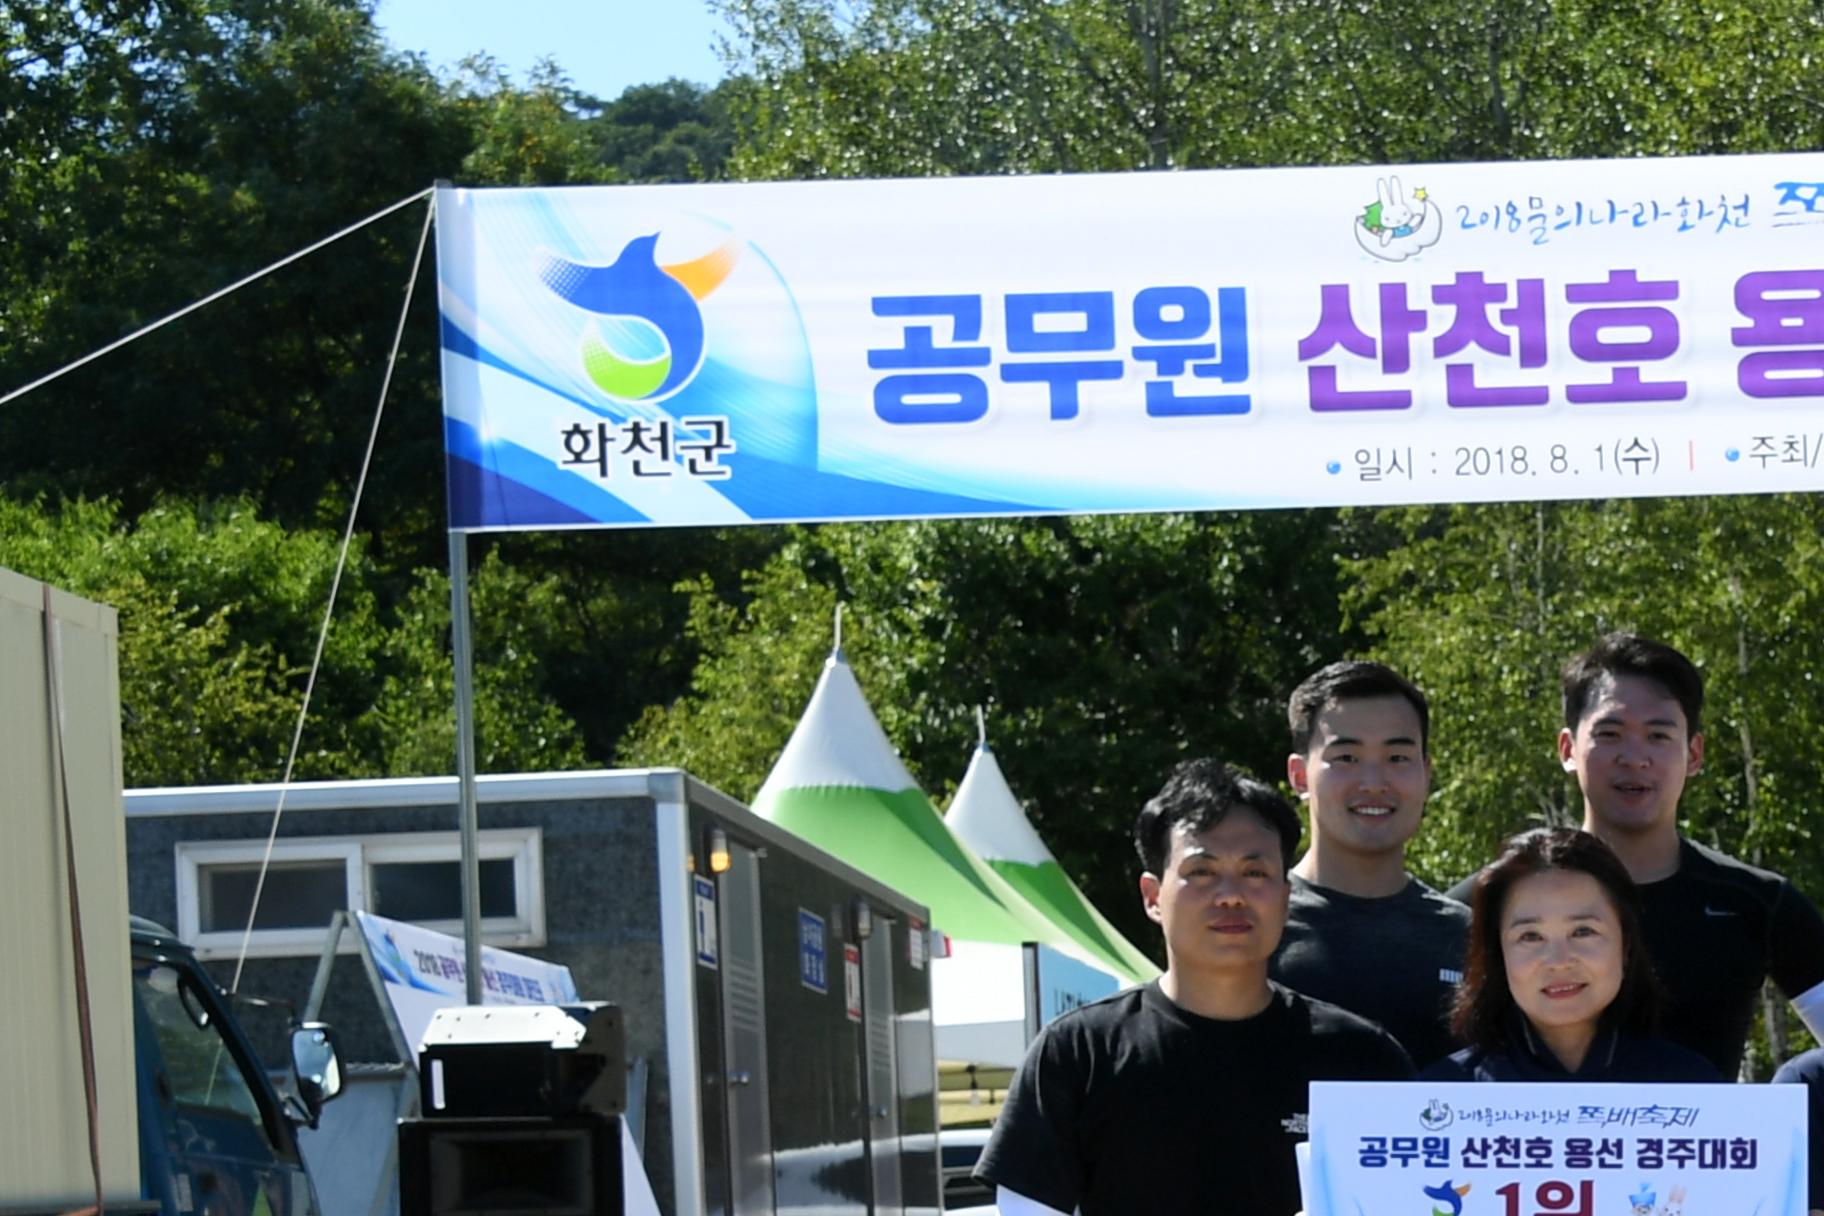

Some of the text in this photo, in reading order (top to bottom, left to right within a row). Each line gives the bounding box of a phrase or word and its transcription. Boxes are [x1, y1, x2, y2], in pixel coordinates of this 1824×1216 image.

[867, 286, 1251, 425] 공무원
[1298, 269, 1687, 412] 산천호
[561, 420, 731, 478] 화천군
[1579, 1104, 1699, 1128] 쪽배축제
[1359, 1136, 1757, 1169] 공무원 산천호 용선 경주대회
